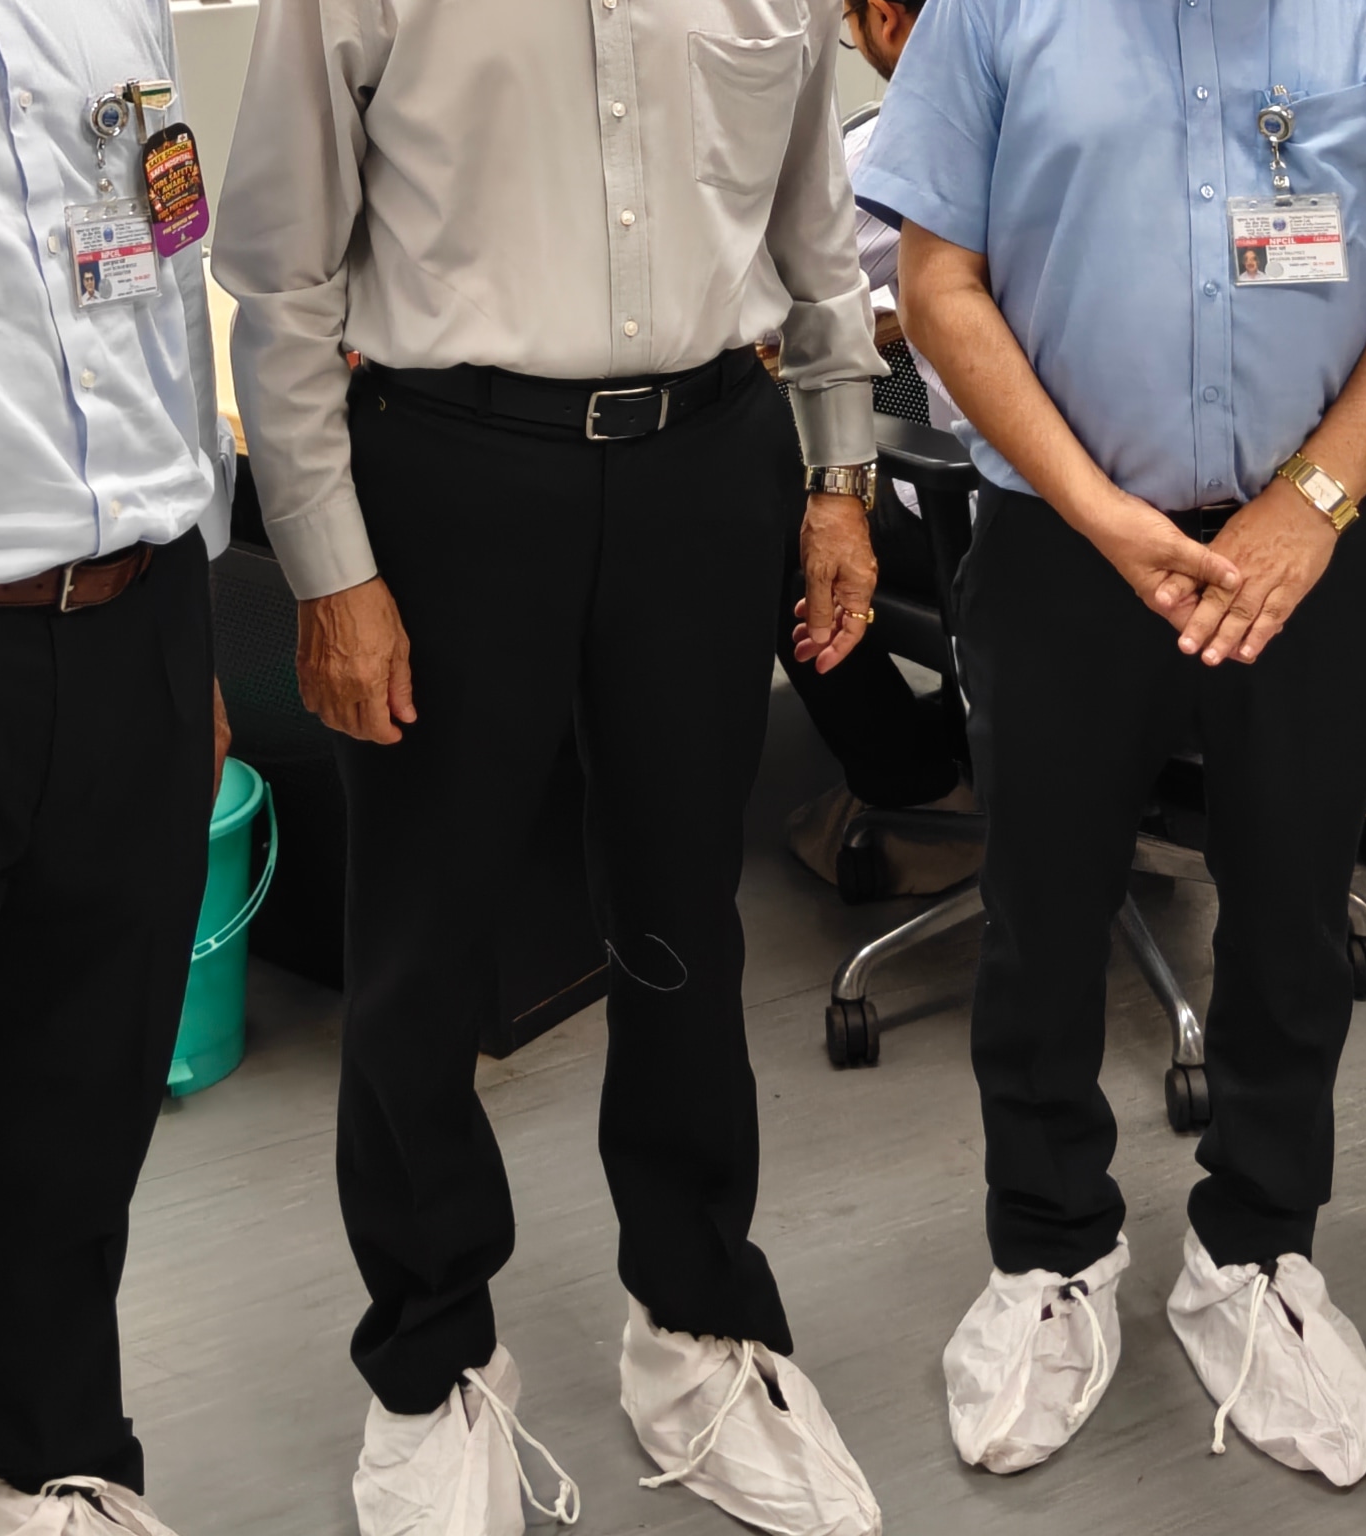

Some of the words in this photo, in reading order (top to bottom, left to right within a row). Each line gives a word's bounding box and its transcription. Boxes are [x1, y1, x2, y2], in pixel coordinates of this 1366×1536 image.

[149, 155, 164, 167] SAFE
[165, 144, 189, 159] SCHOOL
[154, 176, 168, 190] FIRE
[168, 166, 193, 182] SAFETY
[162, 176, 186, 193] AWARE
